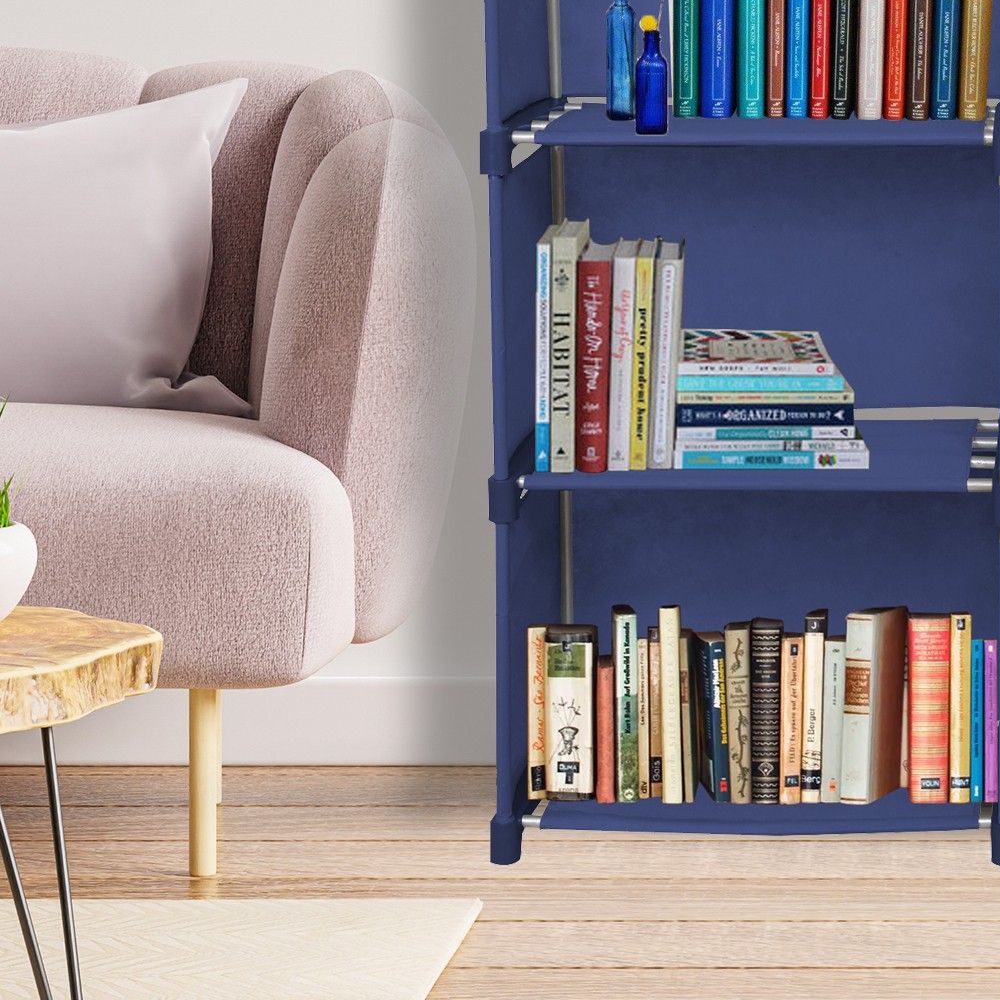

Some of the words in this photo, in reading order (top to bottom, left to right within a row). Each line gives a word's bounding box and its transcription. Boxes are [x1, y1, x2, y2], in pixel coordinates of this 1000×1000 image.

[637, 308, 648, 346] pretty
[552, 312, 570, 417] HABITAT
[636, 352, 648, 403] prudent
[807, 708, 816, 735] Berger
